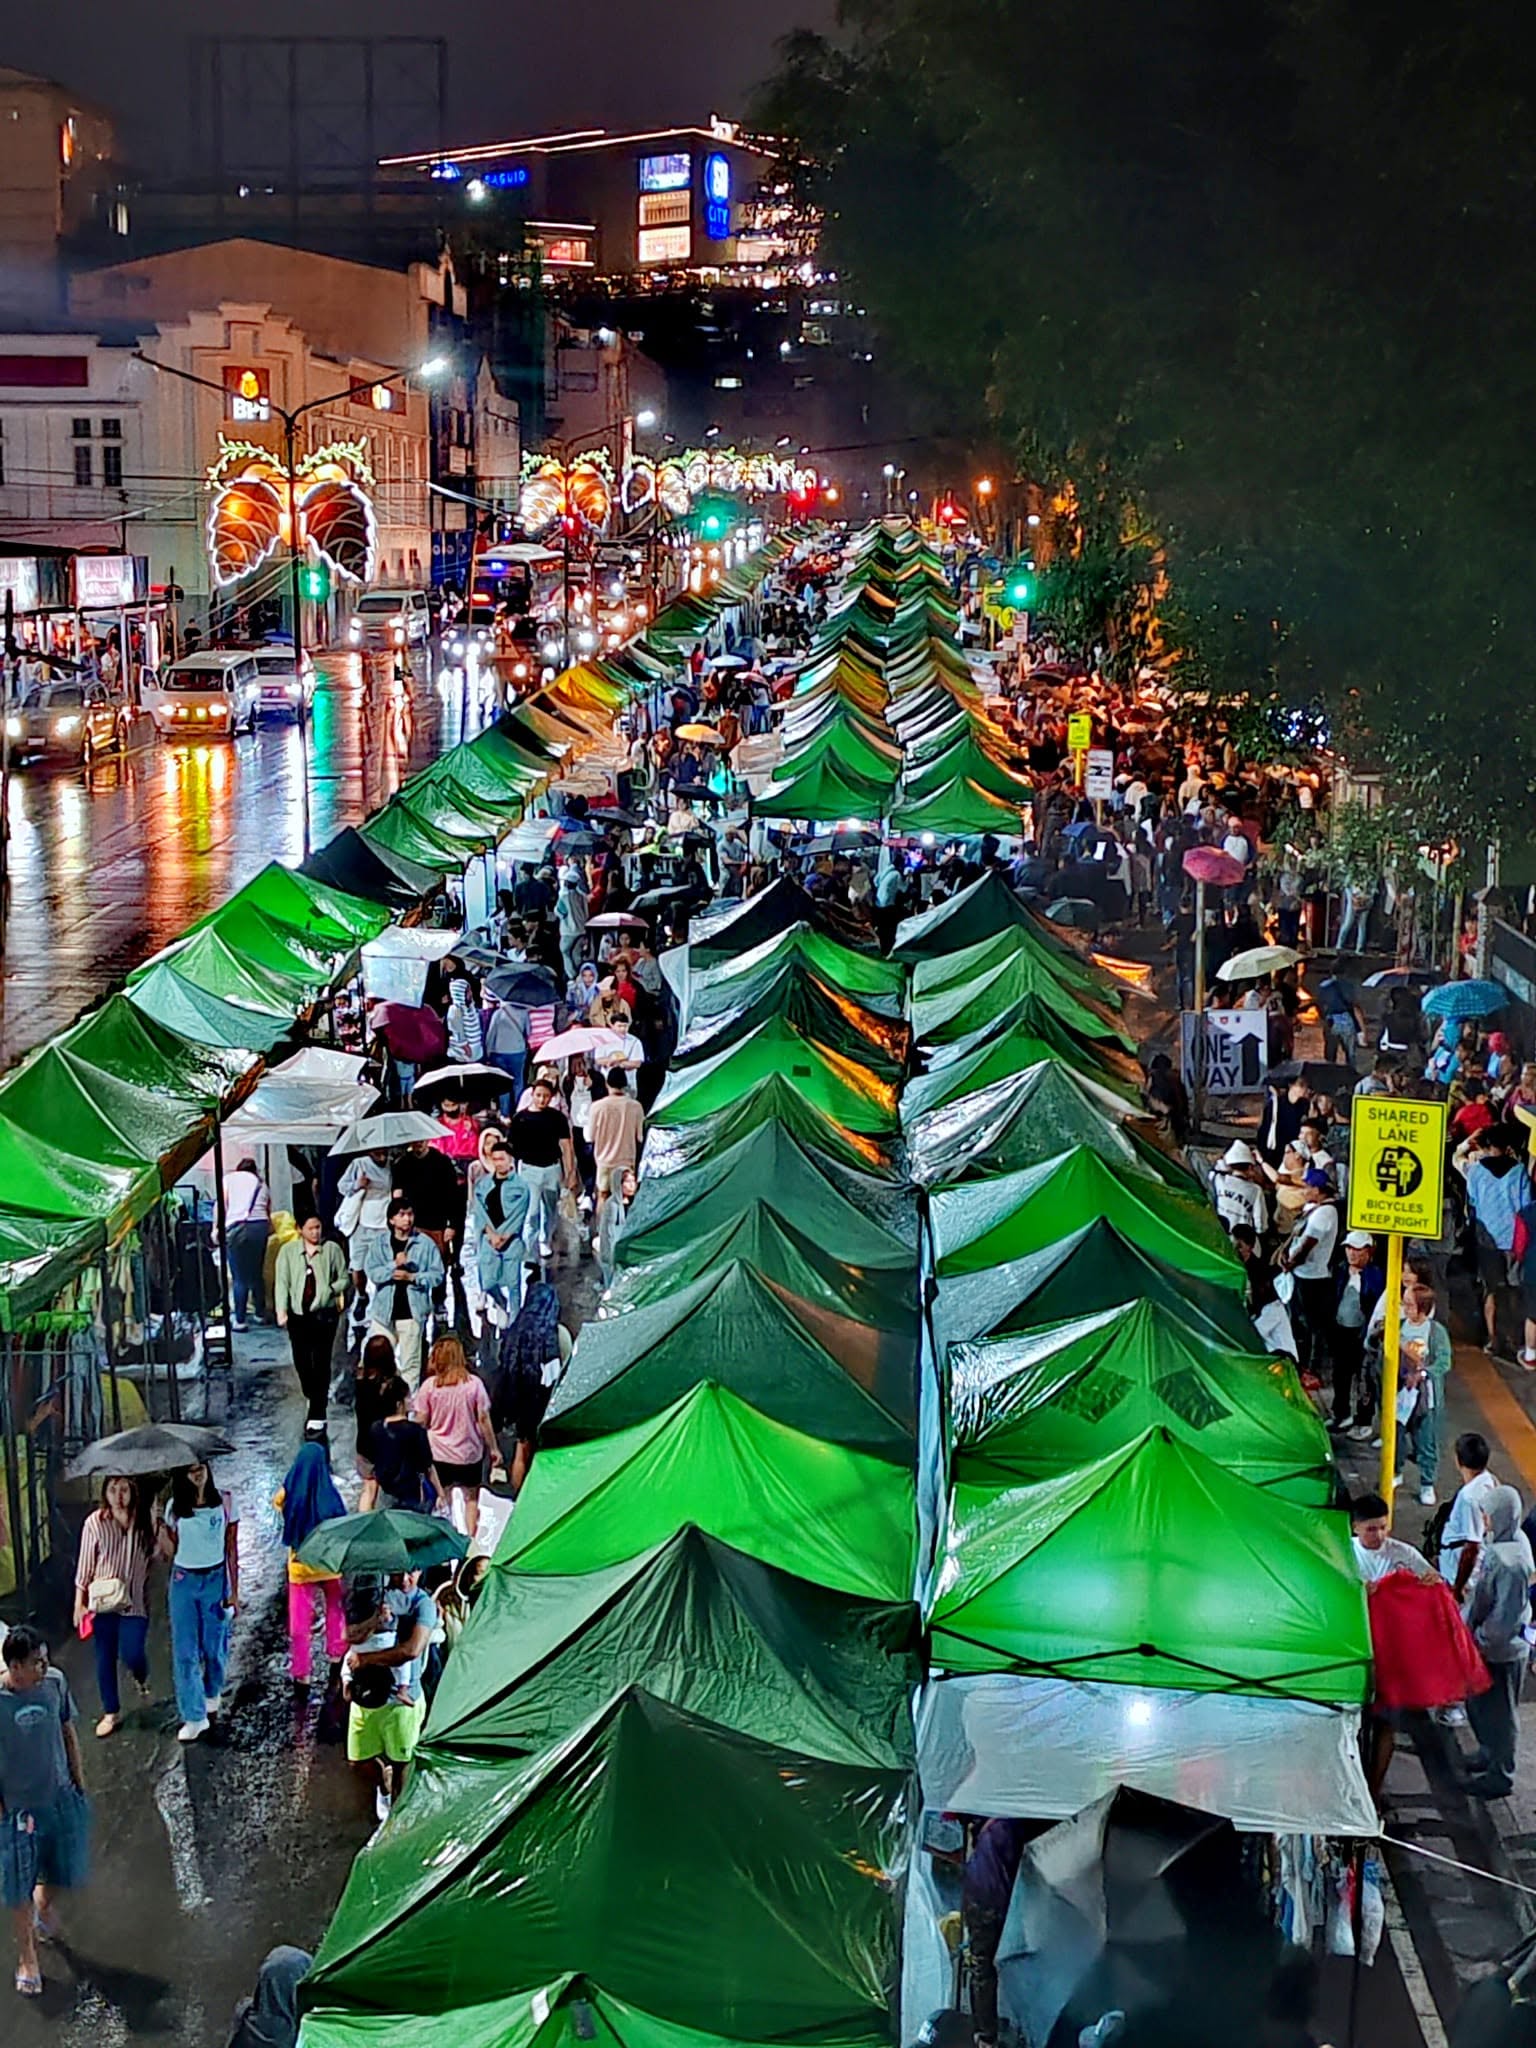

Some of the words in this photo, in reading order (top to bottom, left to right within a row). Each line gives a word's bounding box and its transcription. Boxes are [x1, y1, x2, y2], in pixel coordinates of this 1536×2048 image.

[708, 205, 729, 225] CITY
[1367, 1107, 1430, 1125] SHARED
[1377, 1127, 1420, 1144] LANE
[1366, 1199, 1425, 1214] BICYCLES
[1360, 1213, 1391, 1226] KEEP
[1393, 1216, 1430, 1230] RIGHT
